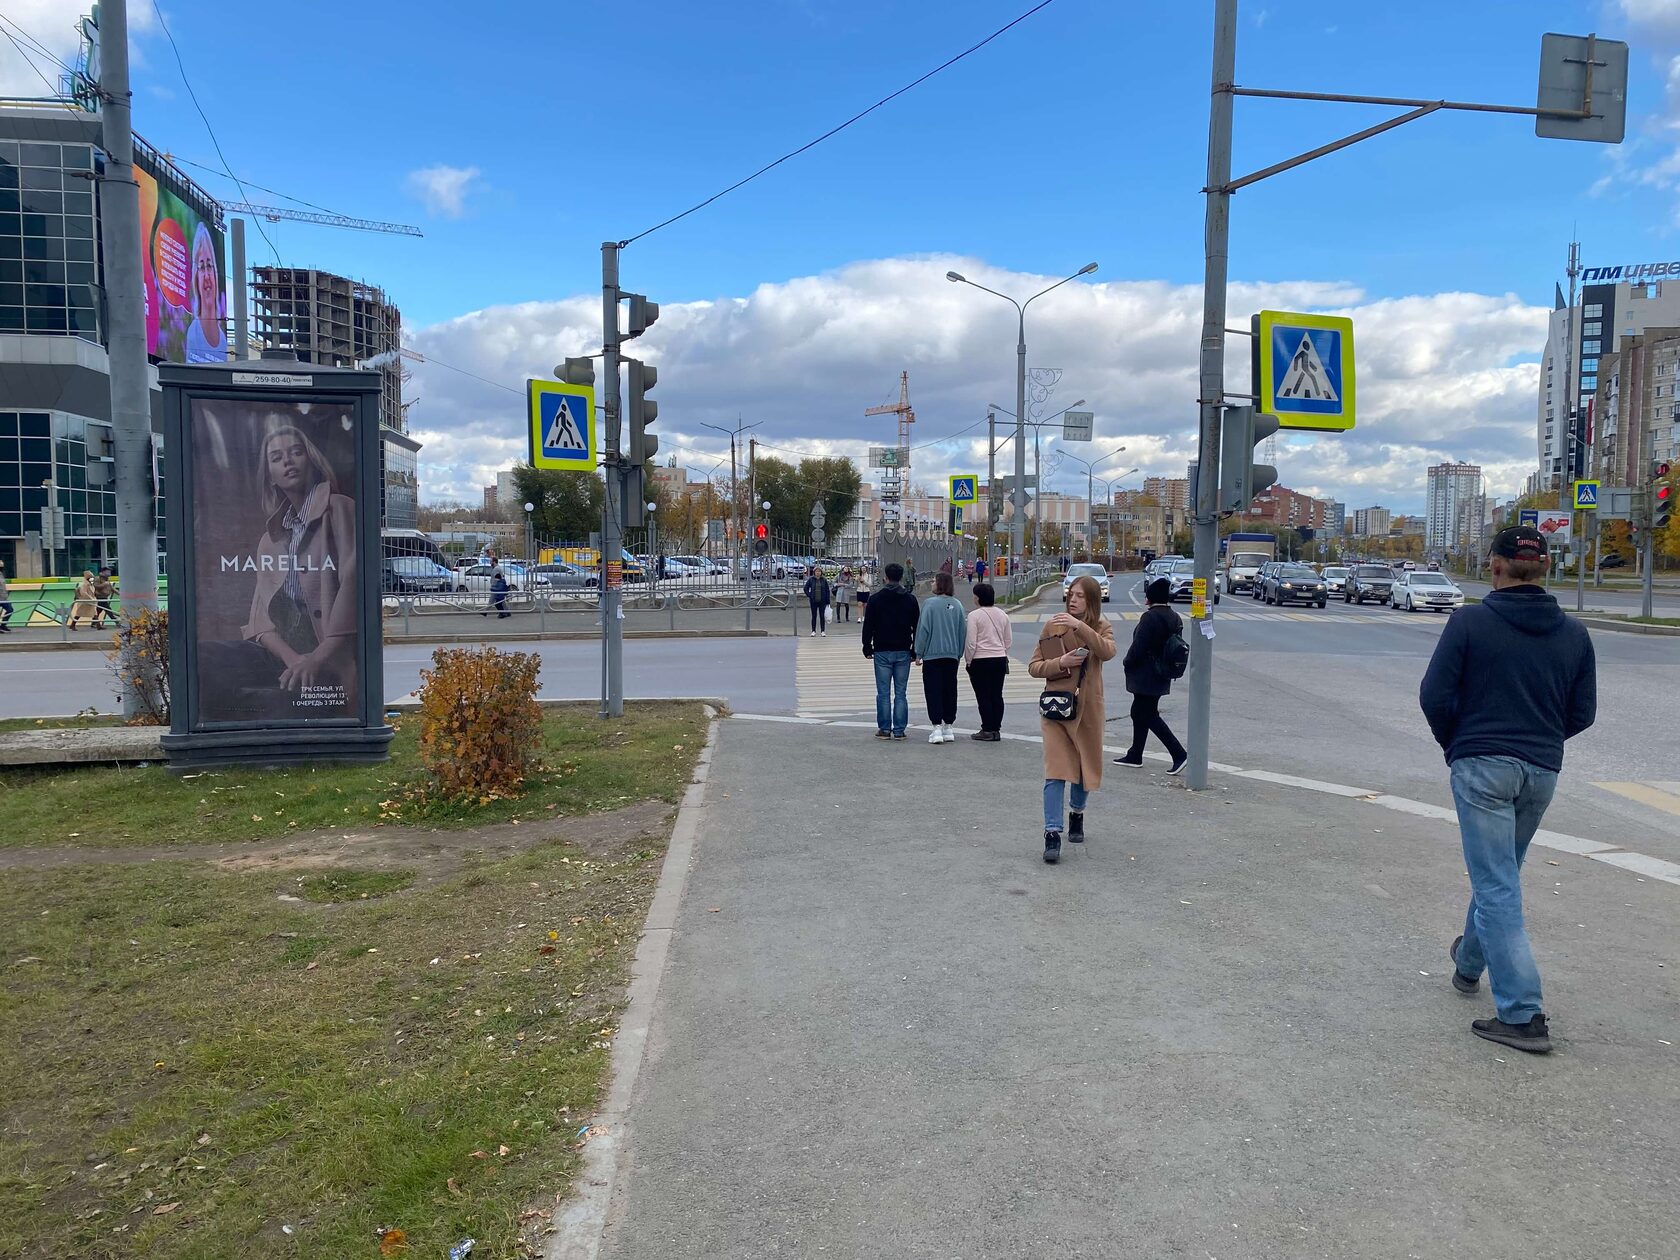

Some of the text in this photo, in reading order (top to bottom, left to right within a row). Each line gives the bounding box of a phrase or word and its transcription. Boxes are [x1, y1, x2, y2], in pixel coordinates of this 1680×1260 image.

[1581, 266, 1623, 281] ПМ
[255, 375, 291, 384] 259-80-40
[220, 554, 337, 572] MARELLA
